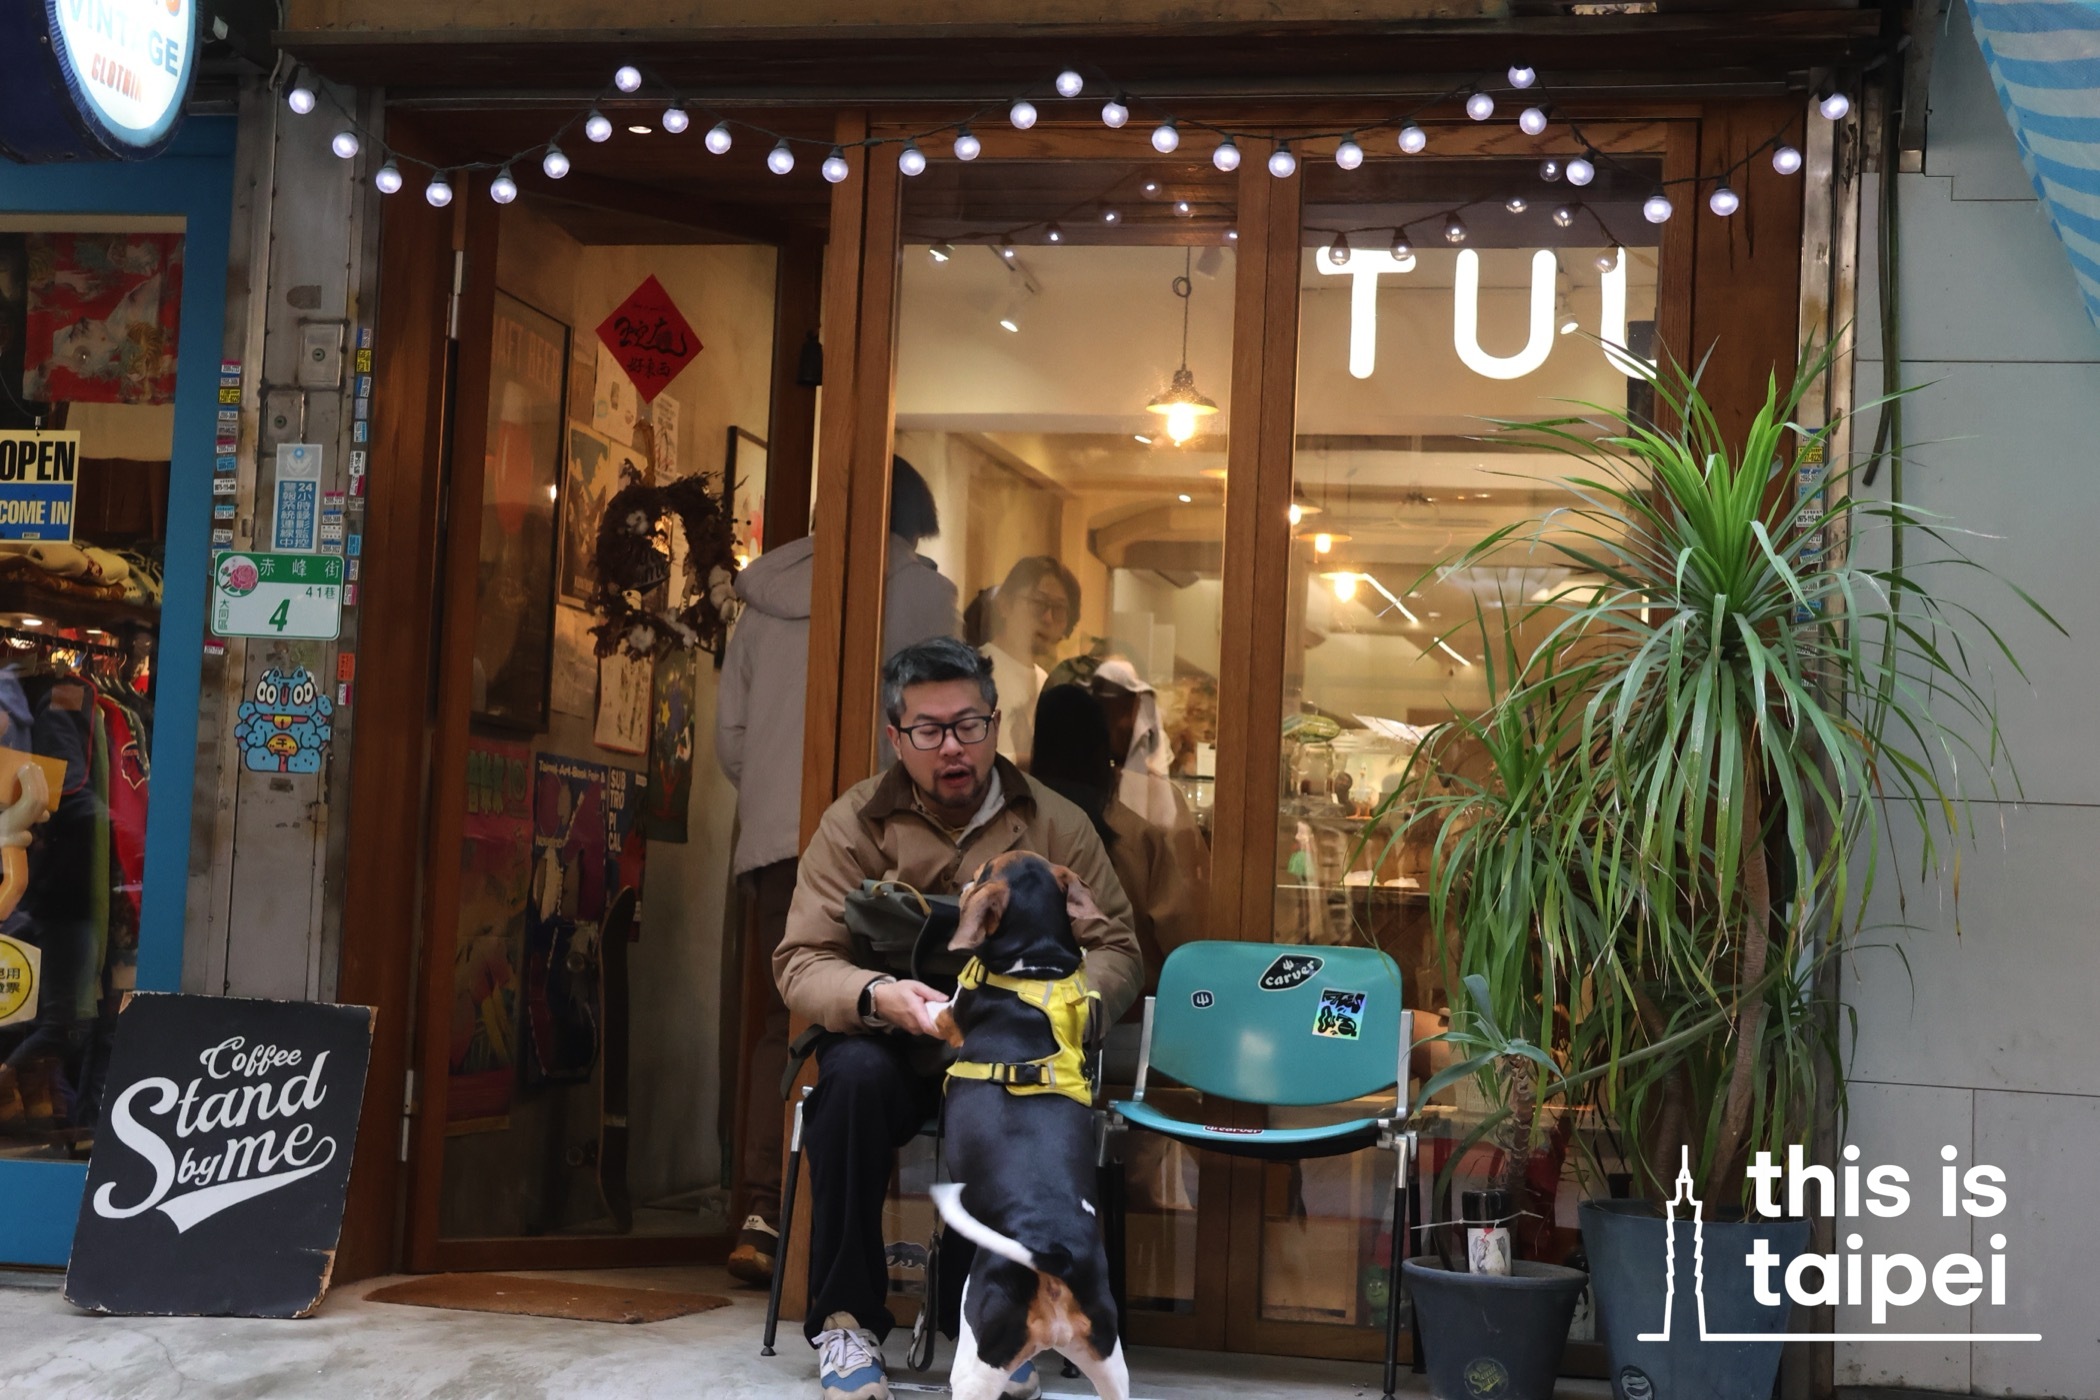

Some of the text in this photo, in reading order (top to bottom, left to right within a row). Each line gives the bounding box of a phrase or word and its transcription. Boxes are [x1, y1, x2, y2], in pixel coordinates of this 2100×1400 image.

[69, 0, 179, 78] VINTGE
[91, 52, 142, 103] CLOTHIN
[0, 440, 76, 482] OPEN
[51, 501, 70, 525] IN
[260, 558, 340, 579] 赤峰街
[305, 586, 336, 600] 41巷
[218, 599, 230, 631] 大同區
[268, 598, 291, 632] 4
[610, 769, 626, 790] SUB
[609, 789, 625, 810] TRO
[1265, 960, 1315, 986] carver
[200, 1036, 302, 1080] Coffee
[93, 1050, 331, 1219] Stand
[177, 1123, 337, 1186] by me
